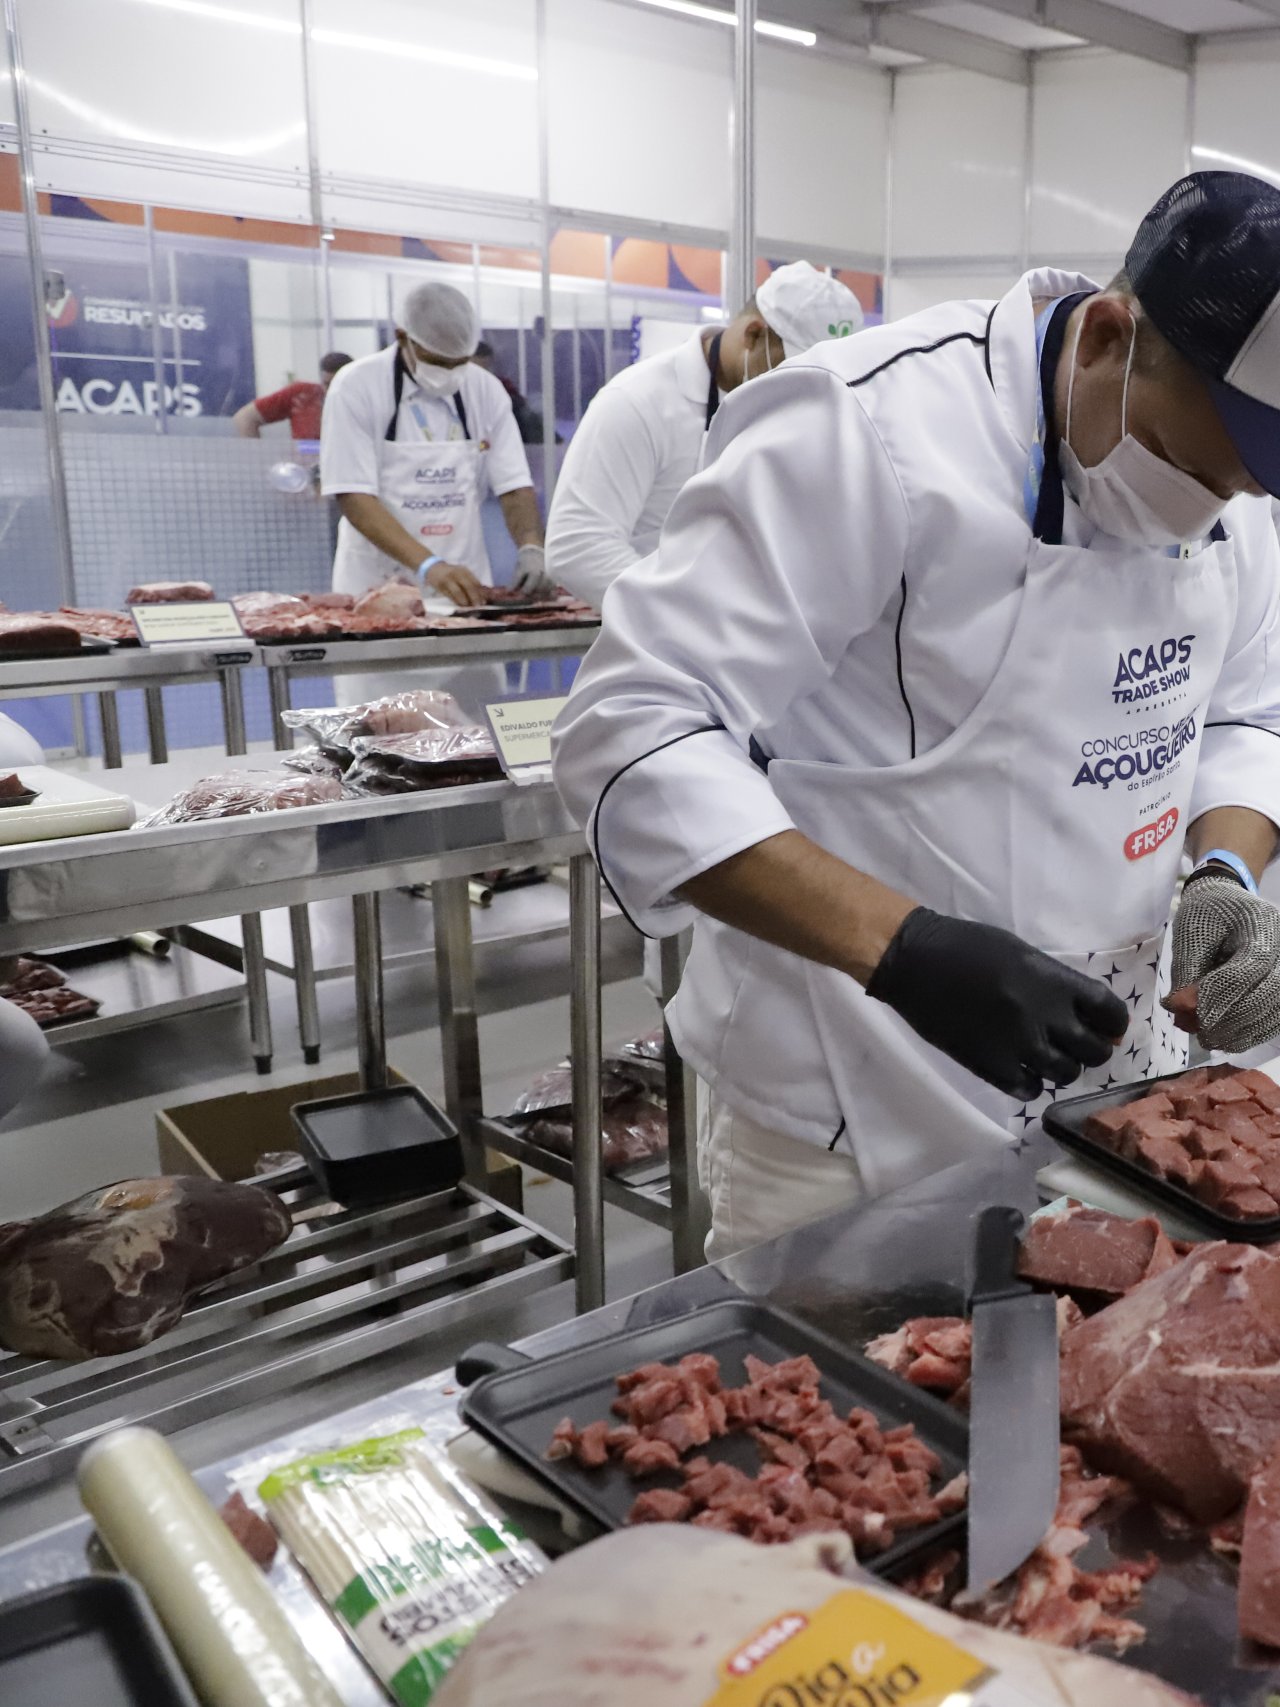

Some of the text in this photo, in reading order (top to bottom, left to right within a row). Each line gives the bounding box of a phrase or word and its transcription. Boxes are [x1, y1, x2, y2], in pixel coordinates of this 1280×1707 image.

[83, 306, 207, 330] RESULDOS
[55, 377, 202, 418] ACAPS
[1113, 634, 1196, 688] ACAPS
[1112, 664, 1191, 704] TRADE SHOW
[500, 721, 538, 732] EDIVALDO
[1081, 726, 1170, 758] CONCURSO
[1072, 716, 1196, 789] AÇOUGUEIRO
[1127, 781, 1139, 791] do
[1131, 814, 1176, 855] FRISA
